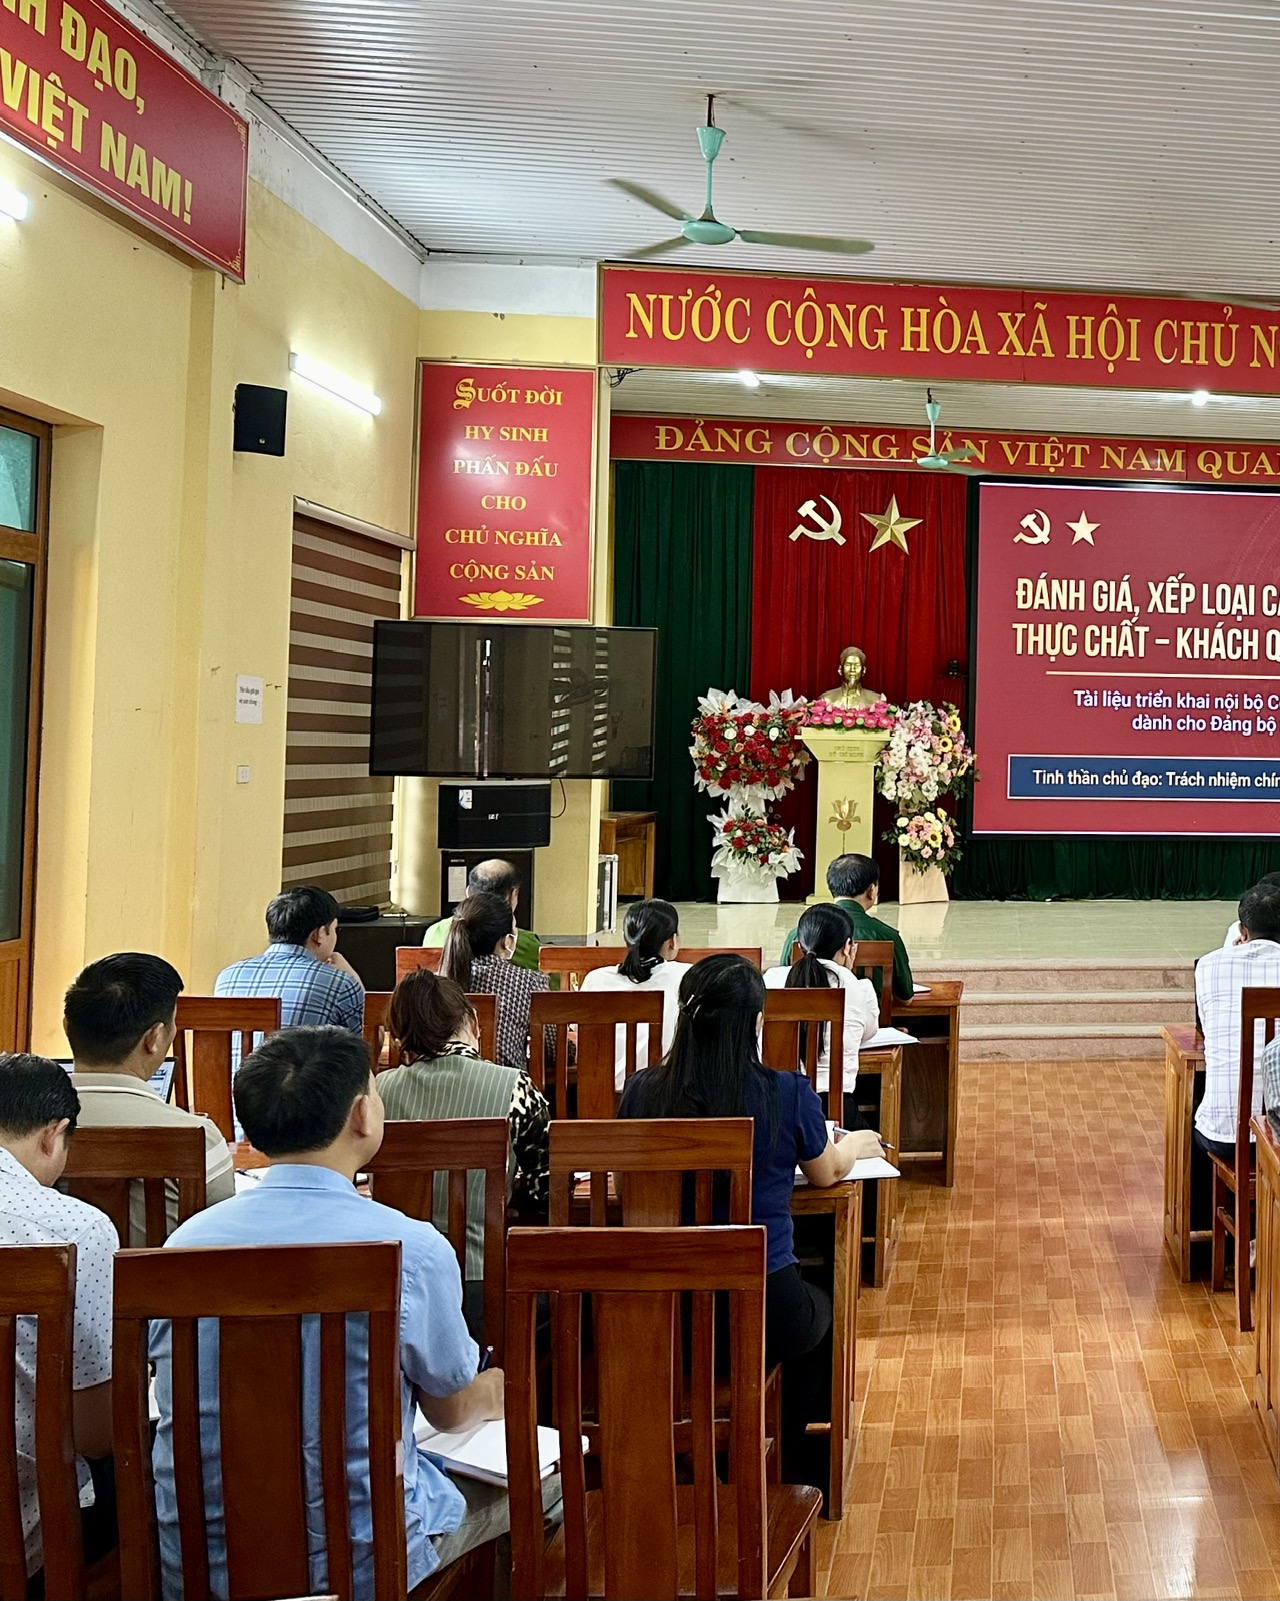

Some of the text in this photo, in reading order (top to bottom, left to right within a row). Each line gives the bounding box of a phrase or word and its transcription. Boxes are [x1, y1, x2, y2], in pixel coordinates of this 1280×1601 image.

[61, 1, 145, 116] ĐẠO,
[0, 47, 193, 225] VIỆT NAM!
[625, 284, 751, 344] NƯỚC
[766, 287, 888, 359] CỘNG
[900, 295, 990, 355] HÒA
[997, 302, 1055, 358] XÃ
[1066, 303, 1142, 374] HỘI
[1153, 305, 1240, 367] CHỦ
[525, 385, 563, 406] ĐỜI
[464, 425, 549, 442] HY SINH
[655, 419, 774, 455] ĐẢNG
[785, 425, 900, 463] CỘNG
[911, 431, 989, 464] SẢN
[998, 437, 1090, 473] VIỆT
[1100, 445, 1186, 473] NAM
[453, 454, 559, 478] PHẤN ĐẤU
[481, 494, 527, 511] CHO
[445, 524, 563, 547] CHỦ NGHĨA
[449, 558, 555, 583] CỘNG SẢN
[1015, 572, 1086, 612] ĐÁNH
[1092, 574, 1141, 617] GIÁ,
[1147, 572, 1196, 614] XẾP
[1201, 583, 1256, 622] LOẠI
[1012, 621, 1078, 662] THỰC
[1084, 617, 1150, 658] CHẤT
[1176, 621, 1259, 661] KHÁCH
[1073, 690, 1098, 707] Tài
[1102, 690, 1132, 710] liệu
[1135, 689, 1172, 708] triển
[1176, 692, 1210, 709] khai
[1214, 693, 1239, 712] nội
[1243, 693, 1264, 713] bộ
[1132, 714, 1173, 731] dành
[1176, 715, 1207, 731] cho
[1210, 714, 1252, 736] Đảng
[1256, 716, 1277, 736] bộ
[1033, 769, 1064, 785] Tinh
[1067, 768, 1099, 786] thần
[1102, 769, 1129, 786] chủ
[1132, 771, 1163, 788] đạo:
[1166, 770, 1205, 787] Trách
[1208, 771, 1251, 789] nhiệm
